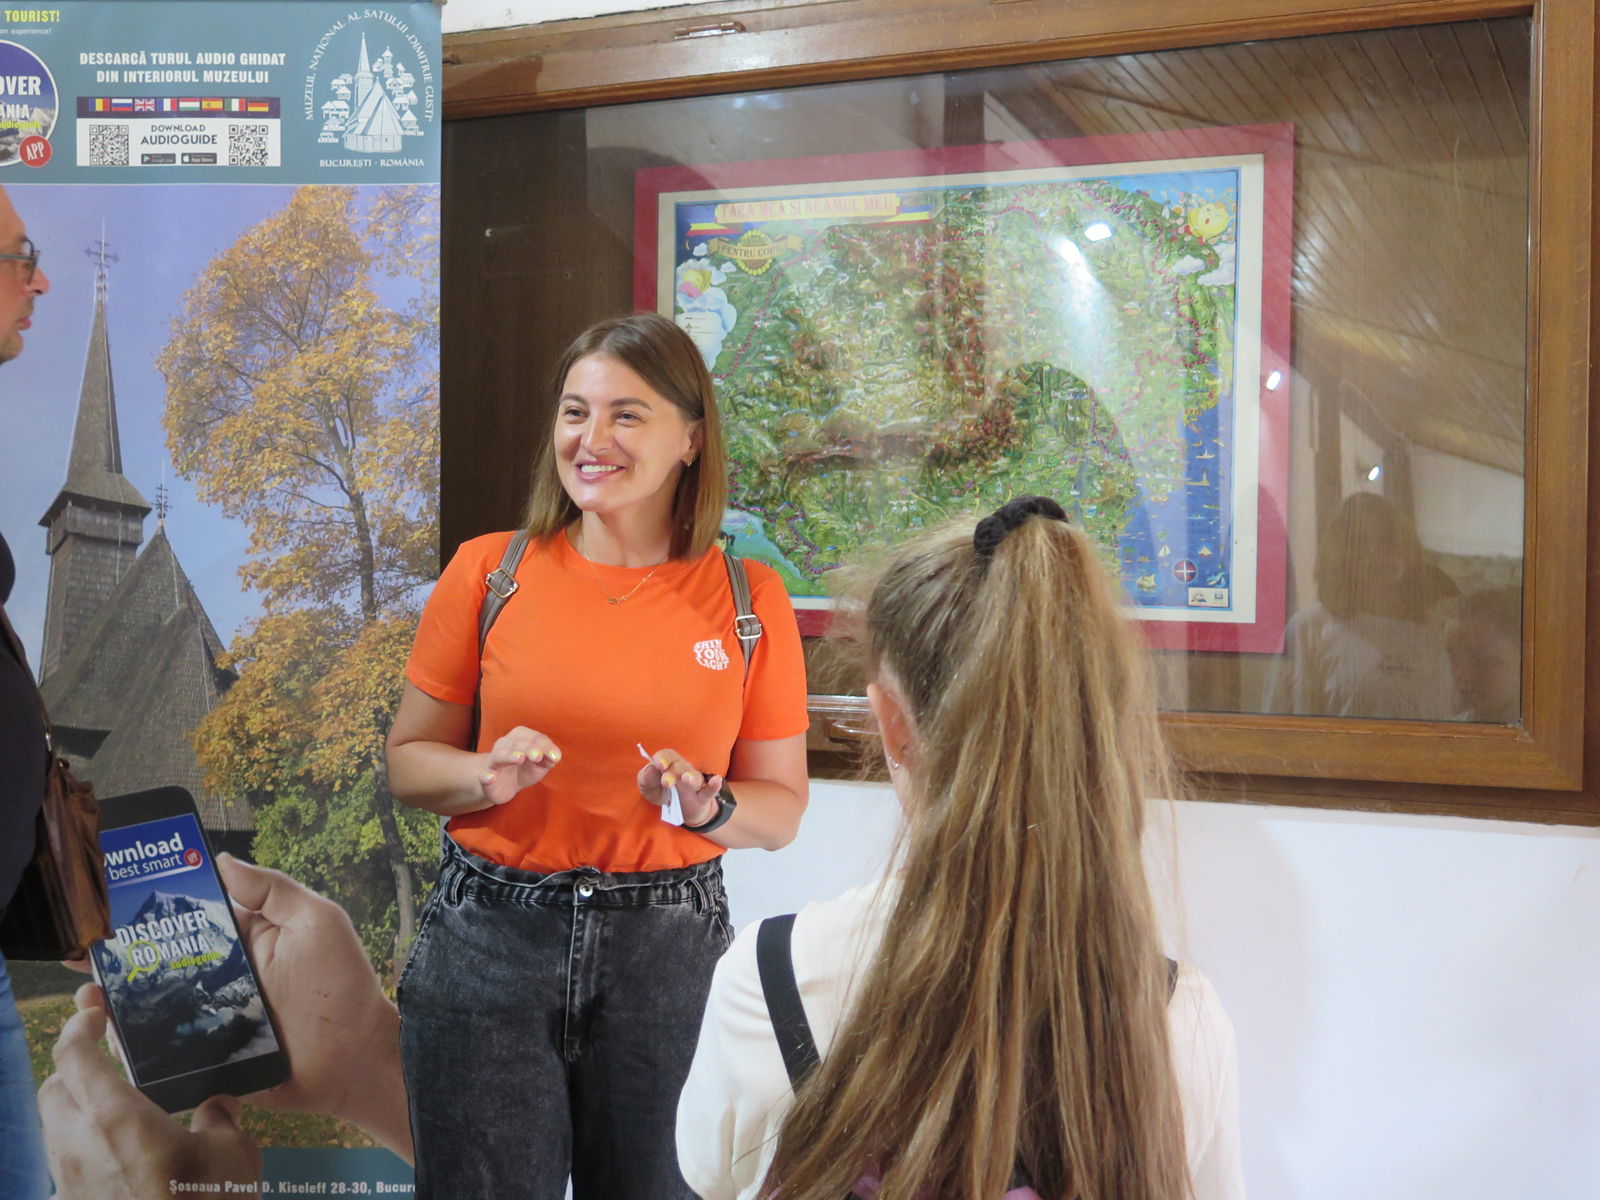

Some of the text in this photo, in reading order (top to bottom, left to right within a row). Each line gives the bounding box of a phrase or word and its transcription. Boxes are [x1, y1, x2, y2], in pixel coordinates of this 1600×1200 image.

[4, 10, 60, 22] TOURIST!
[79, 50, 286, 66] DESCARCĂ TURUL AUDIO GHIDAT
[304, 73, 316, 121] MUZEUL
[347, 11, 361, 23] AL
[364, 9, 409, 34] SATULUI
[96, 70, 269, 83] DIN INTERIORUL MUZEULUI
[151, 124, 206, 133] DOWNLOAD
[140, 134, 218, 146] AUDIOGUIDE
[26, 141, 45, 161] APP
[380, 157, 425, 167] ROMÂNIA
[759, 200, 786, 217] MEA
[863, 194, 894, 211] MEU
[721, 244, 756, 258] PENTRU
[108, 853, 183, 880] best smart
[115, 909, 210, 947] DISCOVER
[131, 934, 209, 967] ROMANIA
[170, 951, 222, 970] audioguide
[224, 1181, 258, 1193] Pavel
[261, 1181, 274, 1193] D.
[278, 1181, 327, 1194] Kiseleff
[330, 1182, 372, 1195] 28-30,
